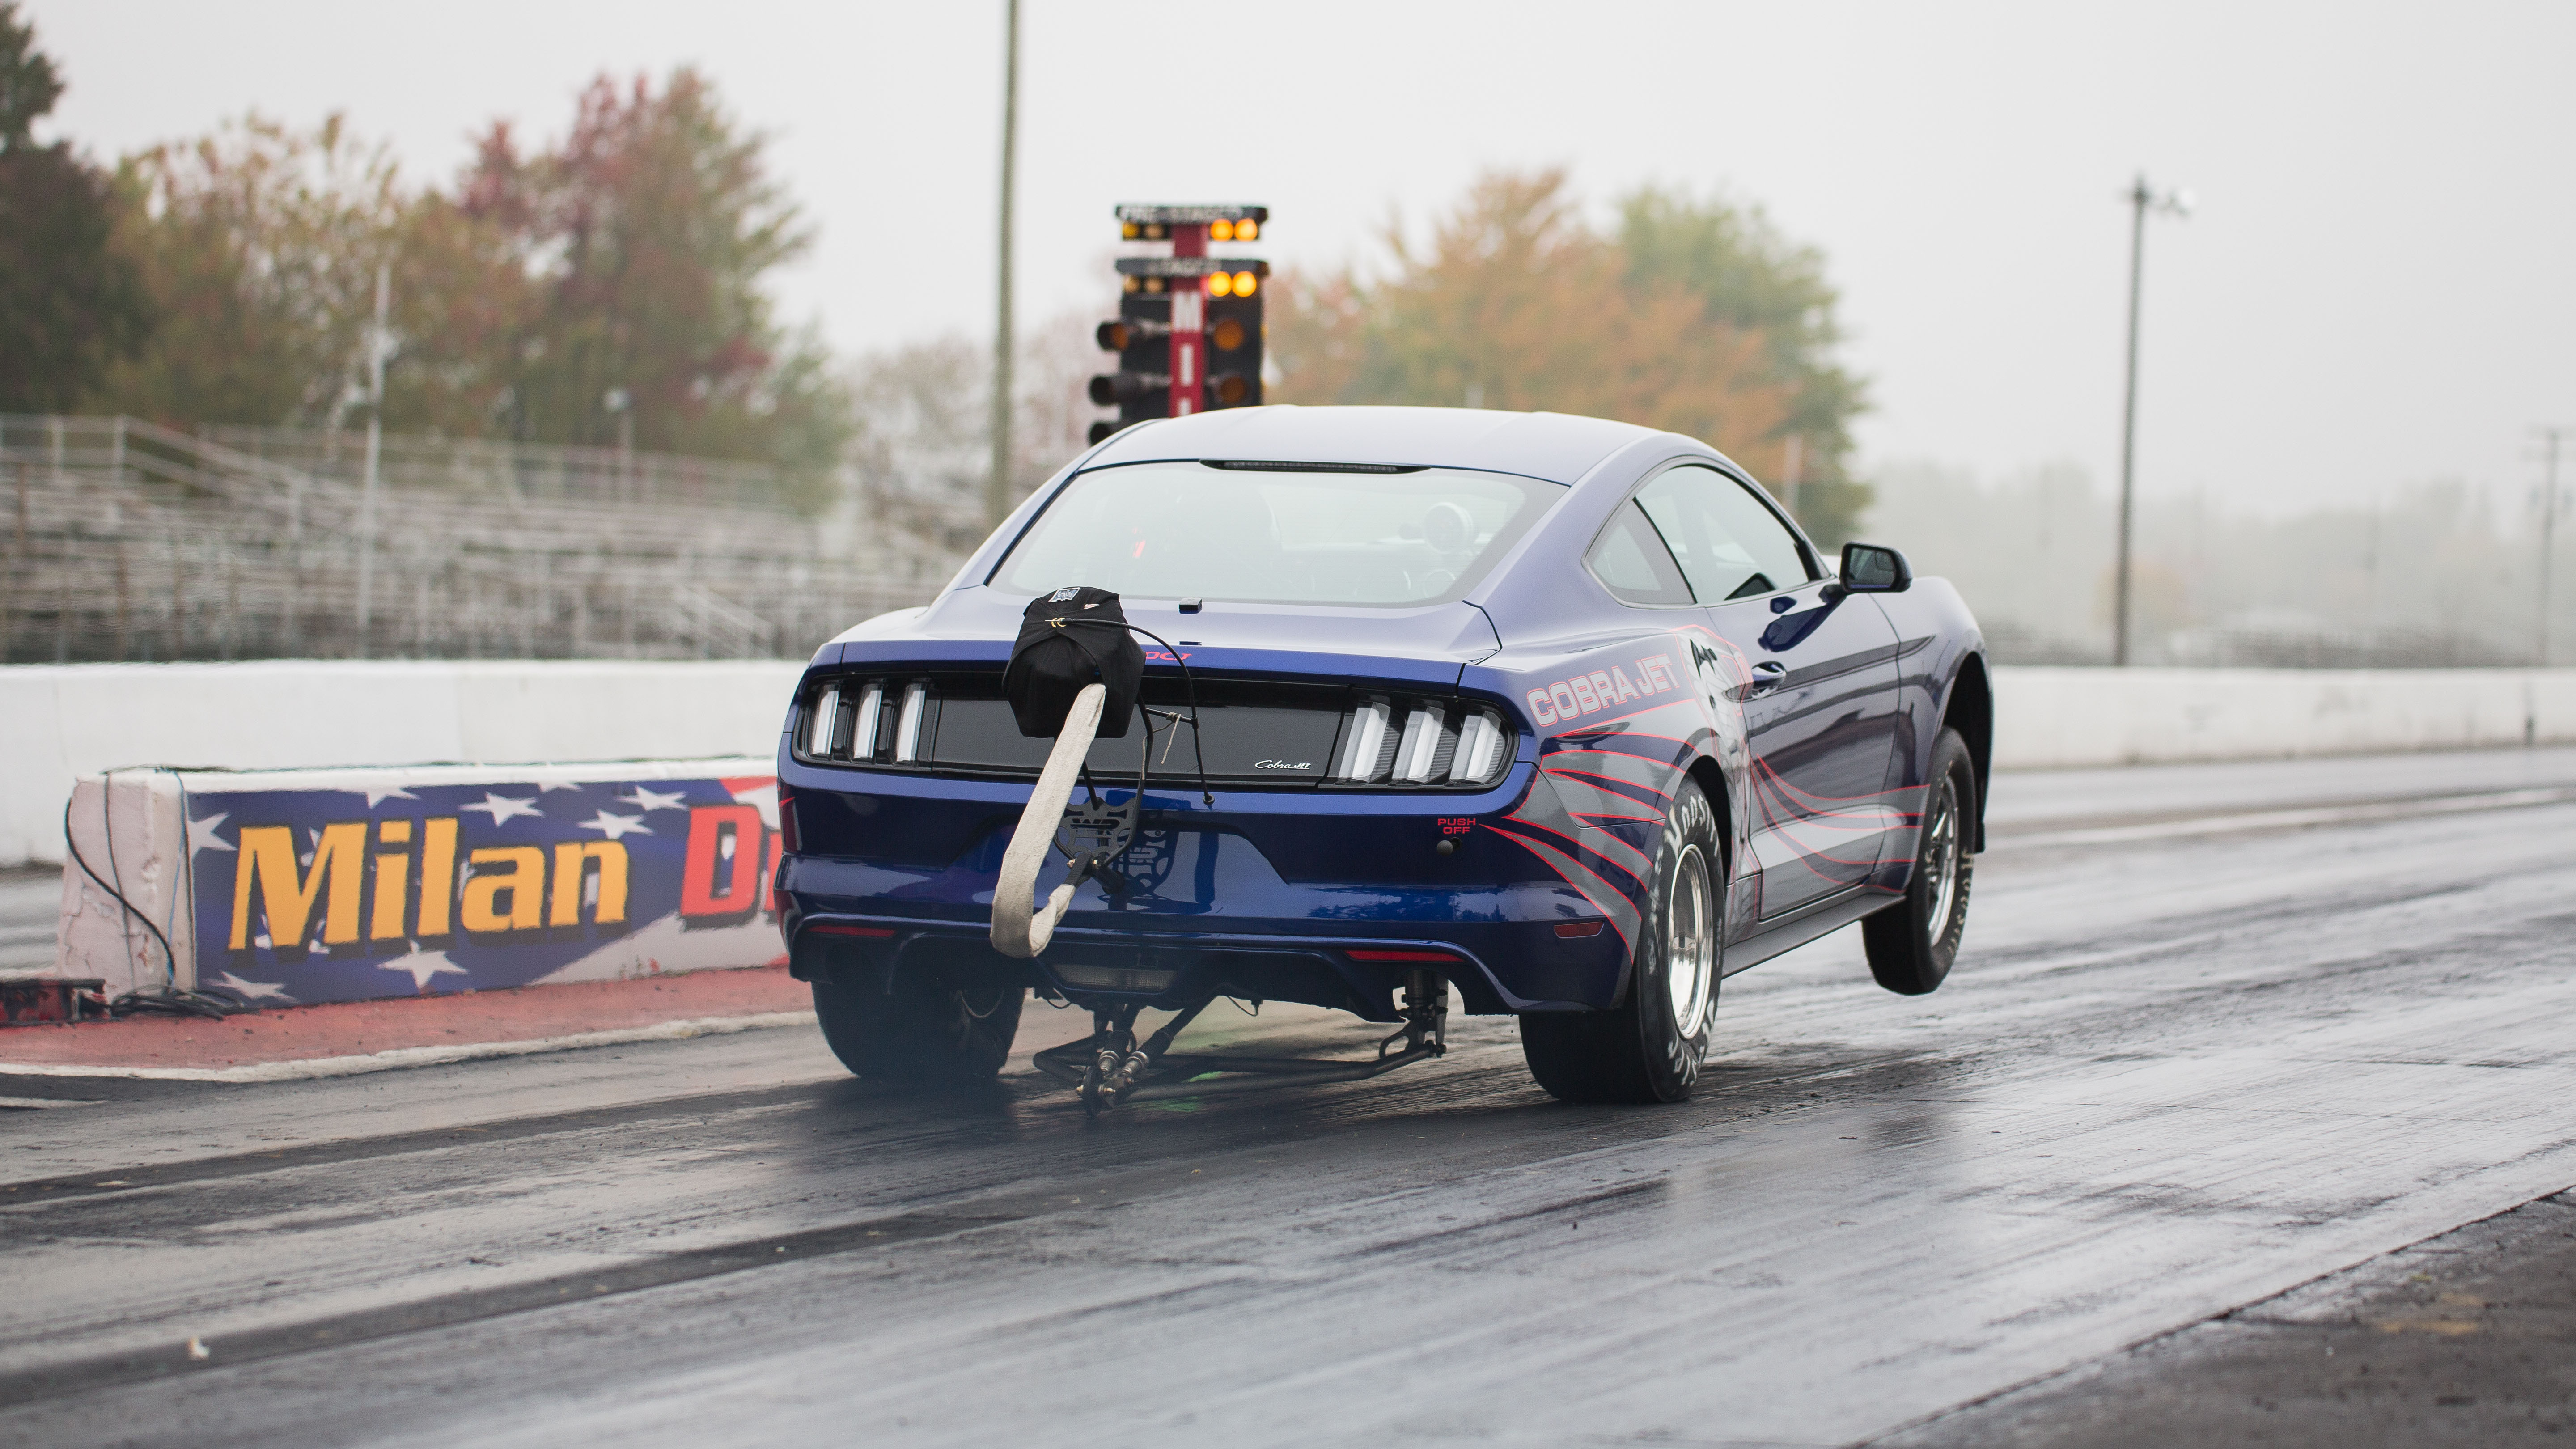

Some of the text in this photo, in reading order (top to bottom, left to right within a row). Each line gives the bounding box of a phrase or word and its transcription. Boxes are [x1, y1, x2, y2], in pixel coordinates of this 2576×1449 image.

[1527, 653, 1680, 727] COBRA JET
[1255, 760, 1291, 769] Cobra
[228, 817, 629, 951] Milan
